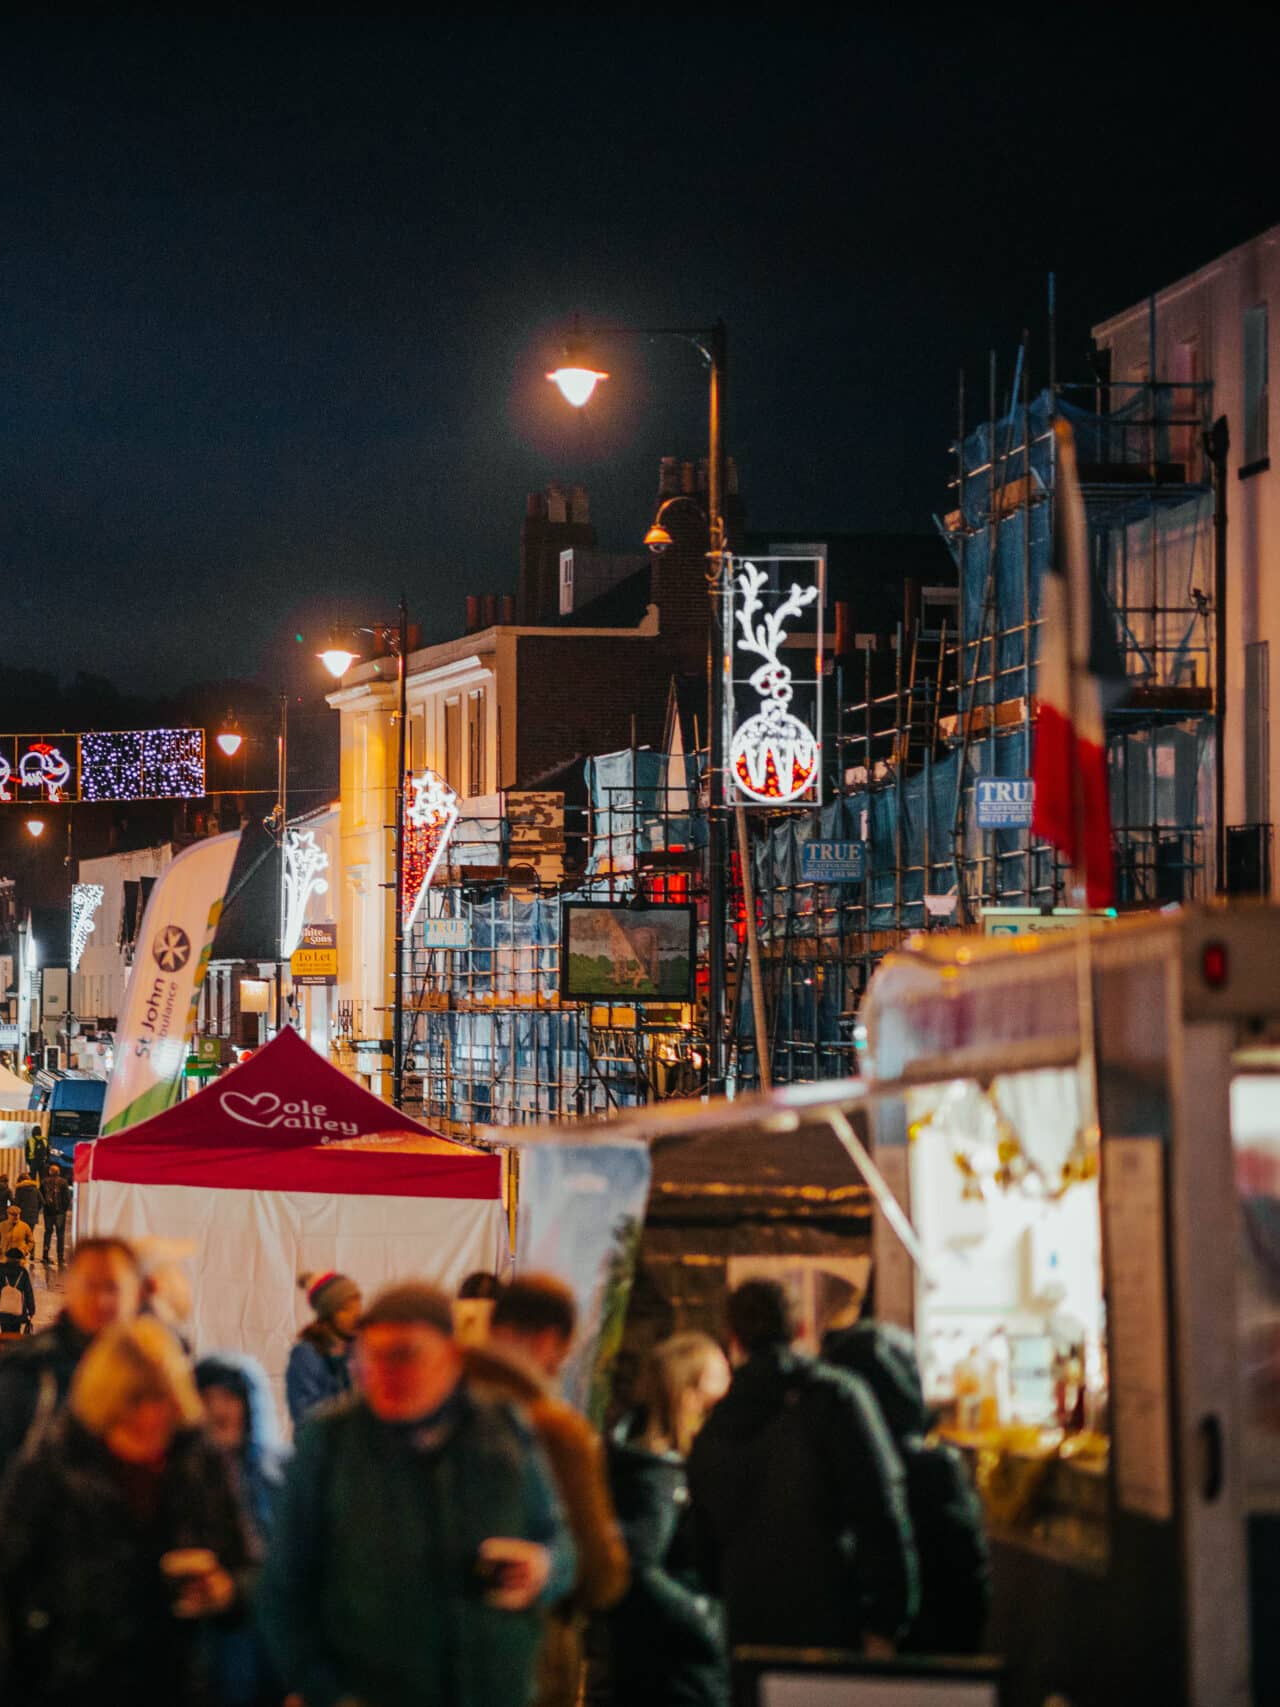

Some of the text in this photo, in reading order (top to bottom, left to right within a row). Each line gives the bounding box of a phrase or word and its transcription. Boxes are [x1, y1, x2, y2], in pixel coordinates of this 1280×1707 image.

[979, 783, 1029, 801] TRU
[806, 844, 861, 860] TRUE
[297, 952, 330, 961] To Let
[135, 978, 165, 1057] St John
[158, 982, 178, 1040] bulance
